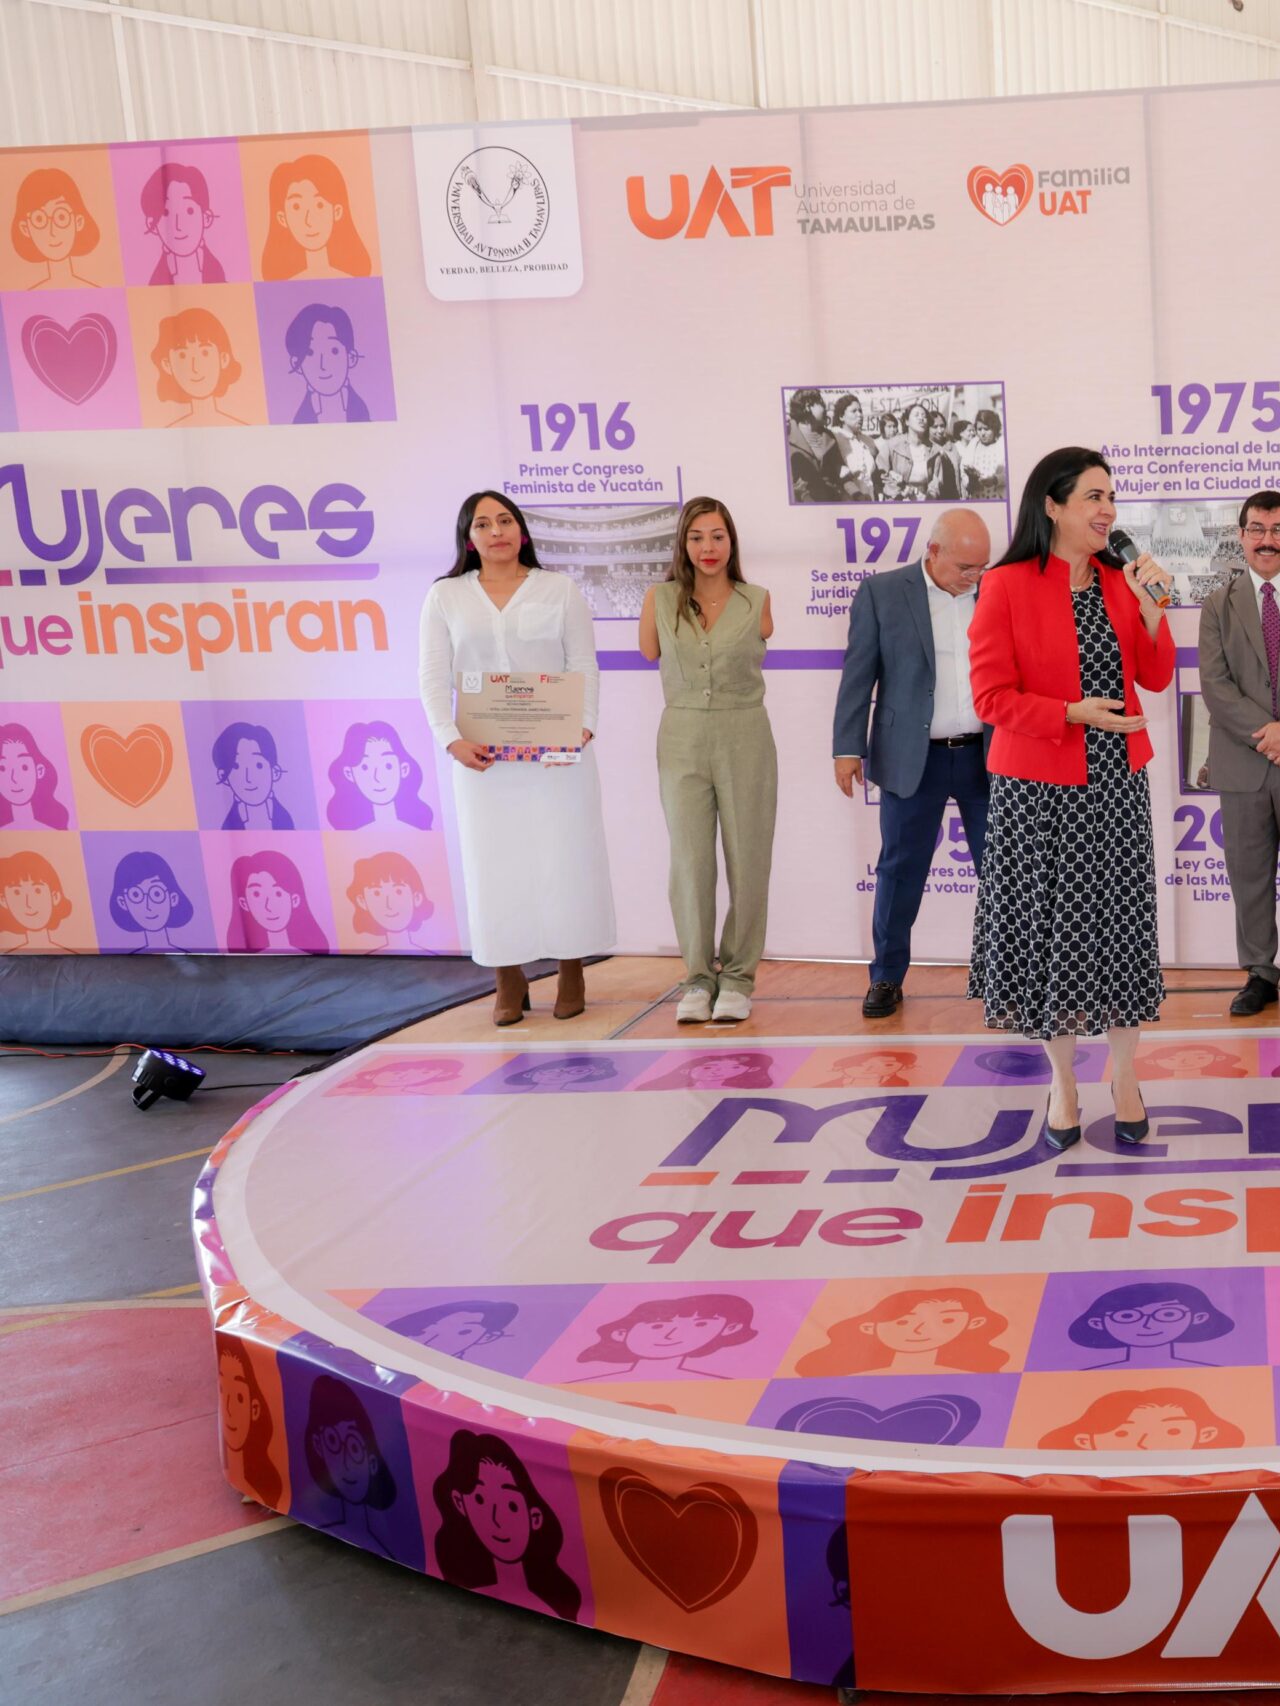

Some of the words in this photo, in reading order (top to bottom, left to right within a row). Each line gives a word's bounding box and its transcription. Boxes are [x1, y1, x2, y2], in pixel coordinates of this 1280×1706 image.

[1038, 166, 1130, 188] Familia
[794, 180, 896, 199] Universidad
[626, 164, 792, 240] UAT
[796, 196, 889, 214] Autónoma
[893, 195, 916, 210] de
[1038, 190, 1092, 216] UAT
[797, 213, 936, 235] TAMAULIPAS
[440, 267, 478, 276] VERDAD,
[480, 264, 522, 274] BELLEZA,
[523, 263, 569, 272] PROBIDAD
[520, 402, 635, 452] 1916
[1100, 444, 1130, 458] Año
[1134, 441, 1239, 457] Internacional
[1243, 440, 1263, 454] de
[1266, 440, 1280, 453] la
[519, 464, 569, 477] Primer
[572, 462, 645, 478] Congreso
[1147, 459, 1244, 475] Conferencia
[503, 481, 574, 494] Feminista
[577, 480, 596, 493] de
[599, 478, 664, 492] Yucatán
[1115, 479, 1160, 495] Mujer
[1163, 480, 1182, 492] en
[1185, 477, 1200, 490] la
[1204, 476, 1260, 490] Ciudad
[836, 517, 930, 564] 197
[811, 569, 828, 582] Se
[811, 585, 857, 602] jurídic
[806, 602, 850, 618] mujer
[0, 614, 73, 669] ue
[77, 588, 389, 671] inspiran
[490, 674, 510, 683] UAT
[1175, 857, 1200, 872] Ley
[935, 882, 976, 893] votar
[1165, 873, 1184, 885] de
[1187, 873, 1208, 886] las
[1193, 889, 1231, 901] Libre
[588, 1207, 924, 1264] que
